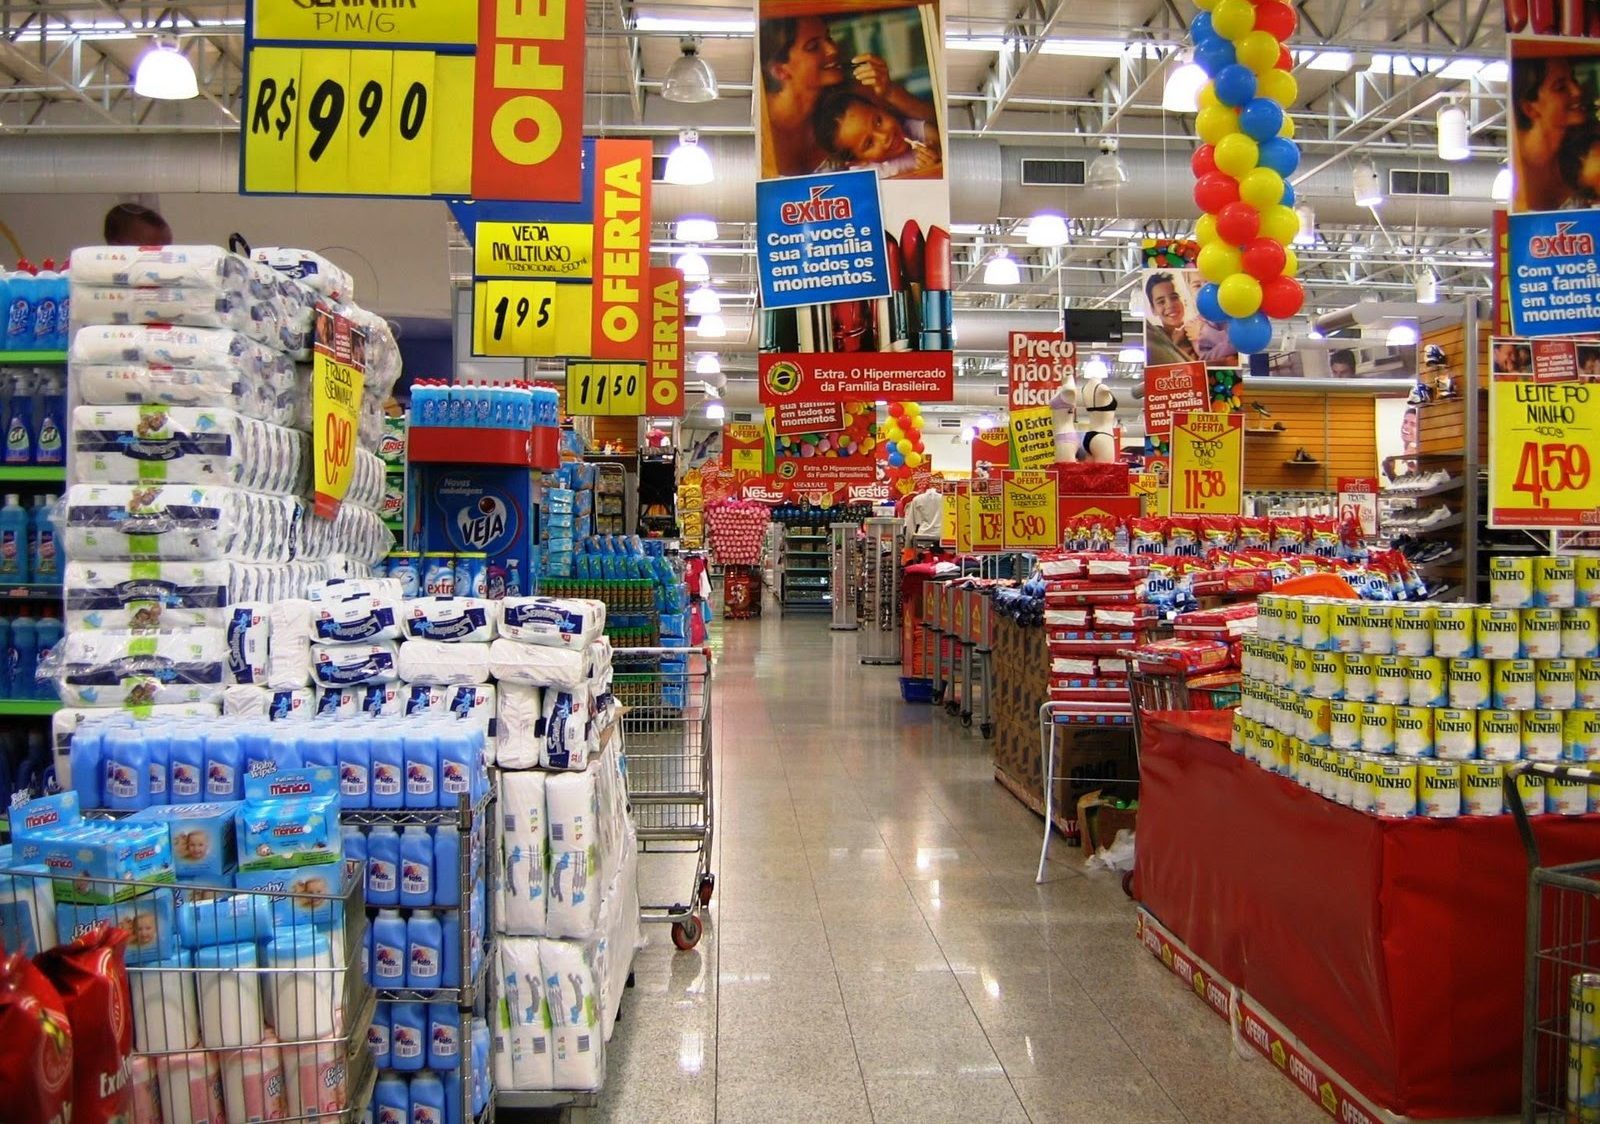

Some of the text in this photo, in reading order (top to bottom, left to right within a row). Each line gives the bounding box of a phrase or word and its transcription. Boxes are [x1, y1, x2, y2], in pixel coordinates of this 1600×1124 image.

[780, 186, 853, 225] extra
[512, 225, 549, 242] VEJA
[767, 223, 871, 247] Com você e
[1529, 223, 1595, 257] extra
[492, 241, 571, 263] MULTIUSO
[600, 157, 644, 344] OFERTA
[769, 238, 873, 262] sua família
[771, 256, 874, 278] em todos os
[1517, 260, 1598, 279] Com você
[772, 272, 877, 293] momentos.
[1519, 279, 1548, 292] sua
[1521, 295, 1547, 307] em
[1548, 290, 1593, 306] todos
[651, 279, 680, 406] OFERTA
[1012, 333, 1074, 365] Preço
[813, 368, 947, 386] Extra. O Hipermercado
[1013, 357, 1051, 382] não
[820, 380, 941, 393] da Família Brasileira.
[1155, 371, 1193, 391] extra
[1148, 390, 1203, 402] Com você e
[1515, 385, 1560, 403] LEITE
[1149, 396, 1203, 411] sua família
[781, 407, 836, 419] em todos os
[781, 415, 838, 427] momentos.
[1150, 411, 1166, 419] em
[1527, 404, 1576, 425] NINHO
[732, 430, 762, 438] OFERTA
[1015, 419, 1023, 432] O
[1190, 423, 1225, 433] OFERTA
[981, 432, 1009, 440] OFERTA
[1018, 429, 1054, 443] cobre a
[461, 513, 505, 546] VEJA
[1148, 579, 1175, 593] OMO
[1395, 614, 1430, 631] NINHO
[1481, 619, 1518, 633] NINHO
[1524, 618, 1560, 633] NINHO
[1539, 669, 1575, 682] NINHO
[1435, 717, 1472, 733] NINHO
[1482, 719, 1519, 734] NINHO
[1524, 719, 1561, 734] NINHO
[1375, 773, 1412, 789] NINHO
[1206, 981, 1229, 1016] OFERTA
[1244, 1015, 1271, 1054] OFERTA
[1289, 1053, 1319, 1096] OFERTA
